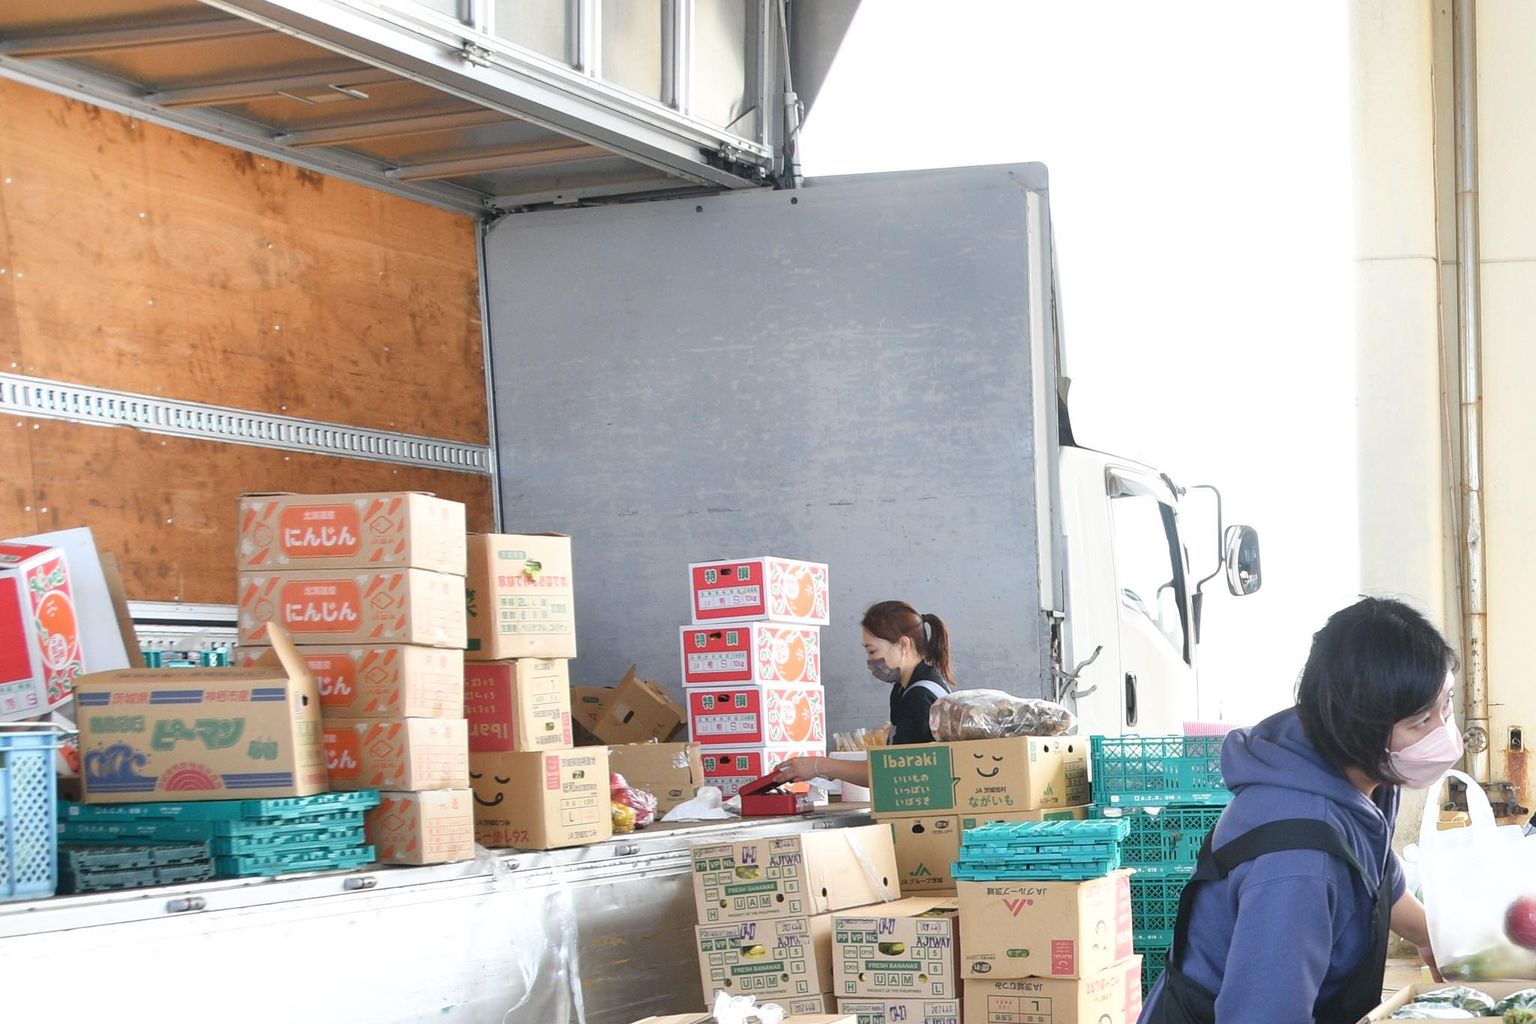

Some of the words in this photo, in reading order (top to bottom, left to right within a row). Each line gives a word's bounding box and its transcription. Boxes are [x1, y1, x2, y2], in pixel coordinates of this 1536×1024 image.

[285, 526, 356, 547] にんじん
[705, 570, 717, 584] 特
[733, 596, 740, 604] S
[286, 602, 357, 622] にんじん
[695, 633, 706, 647] 特
[720, 660, 727, 669] S
[702, 695, 714, 710] 特
[730, 722, 737, 730] S
[152, 717, 246, 751] ピーマン
[704, 757, 716, 771] 特
[884, 752, 937, 769] Ibaraki
[893, 774, 929, 784] いいもの
[895, 786, 930, 795] いっぱい
[896, 797, 931, 806] いばらき
[968, 795, 1014, 808] ながいも
[696, 863, 706, 871] PP
[710, 860, 720, 869] VP
[771, 869, 776, 877] 4
[787, 868, 792, 876] 5
[728, 886, 747, 894] FRESH
[748, 883, 775, 893] BANANAS
[987, 887, 1035, 896] グループ茨城
[1037, 887, 1048, 895] JA
[737, 898, 744, 907] U
[750, 897, 756, 906] A
[762, 896, 770, 905] M
[792, 902, 798, 910] L
[710, 911, 716, 919] H
[837, 934, 848, 942] PP
[851, 934, 862, 942] VP
[702, 942, 712, 950] PP
[715, 941, 726, 949] VP
[734, 966, 751, 974] FRESH
[753, 964, 781, 973] BANANAS
[743, 979, 749, 987] U
[756, 978, 762, 986] A
[769, 977, 776, 985] M
[799, 982, 805, 991] L
[995, 982, 1034, 991] 茨城むつみ
[1034, 983, 1043, 991] JA
[1032, 1001, 1039, 1011] L
[859, 1017, 870, 1024] VP
[873, 1017, 885, 1024] NB
